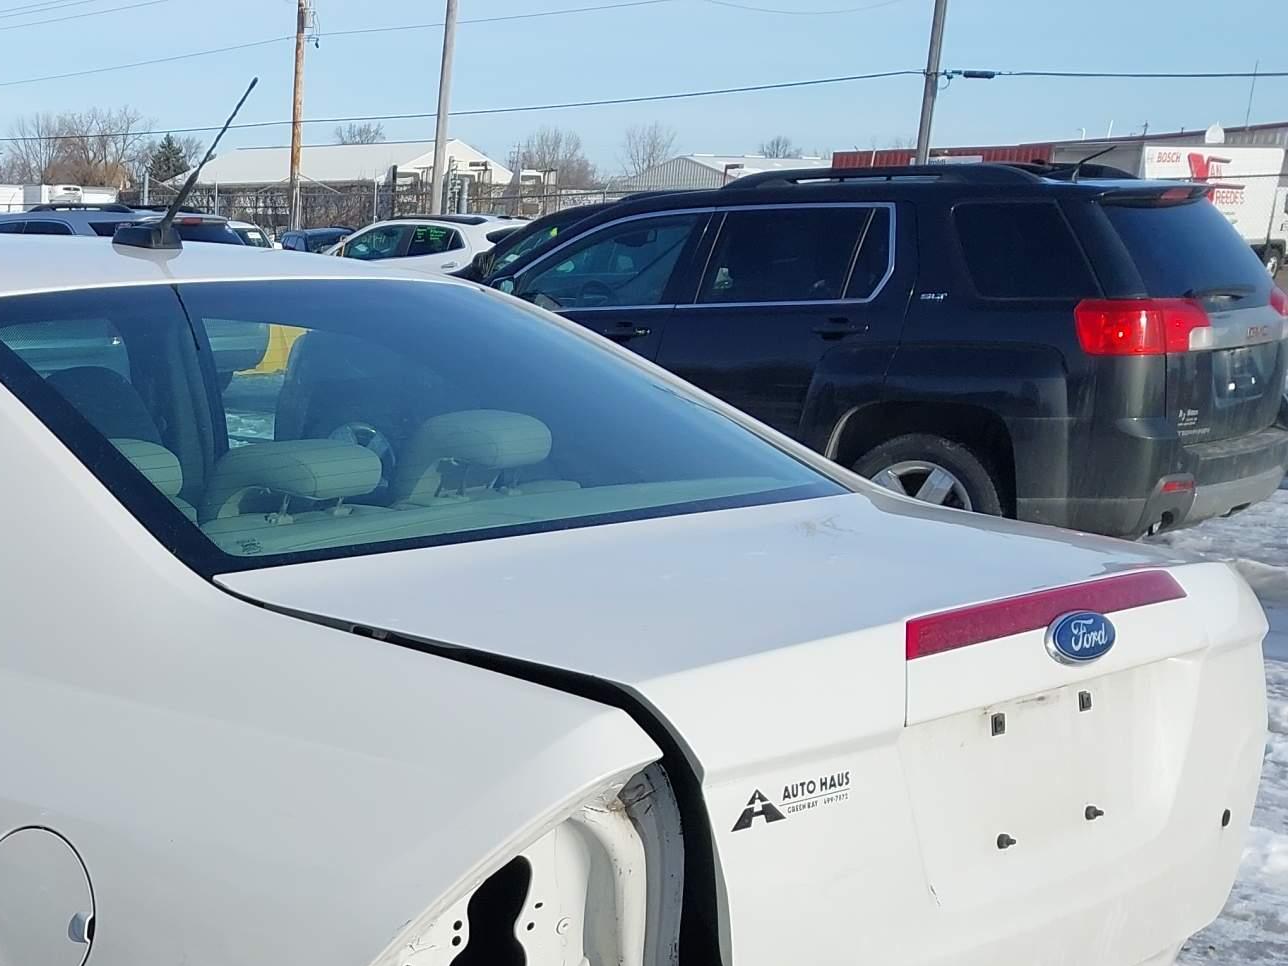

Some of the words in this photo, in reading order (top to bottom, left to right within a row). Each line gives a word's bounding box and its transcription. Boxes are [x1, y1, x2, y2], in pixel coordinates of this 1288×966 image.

[1156, 151, 1182, 163] BOSCH
[1071, 618, 1108, 651] Ford
[783, 780, 816, 801] AUTO
[819, 771, 850, 792] HAUS
